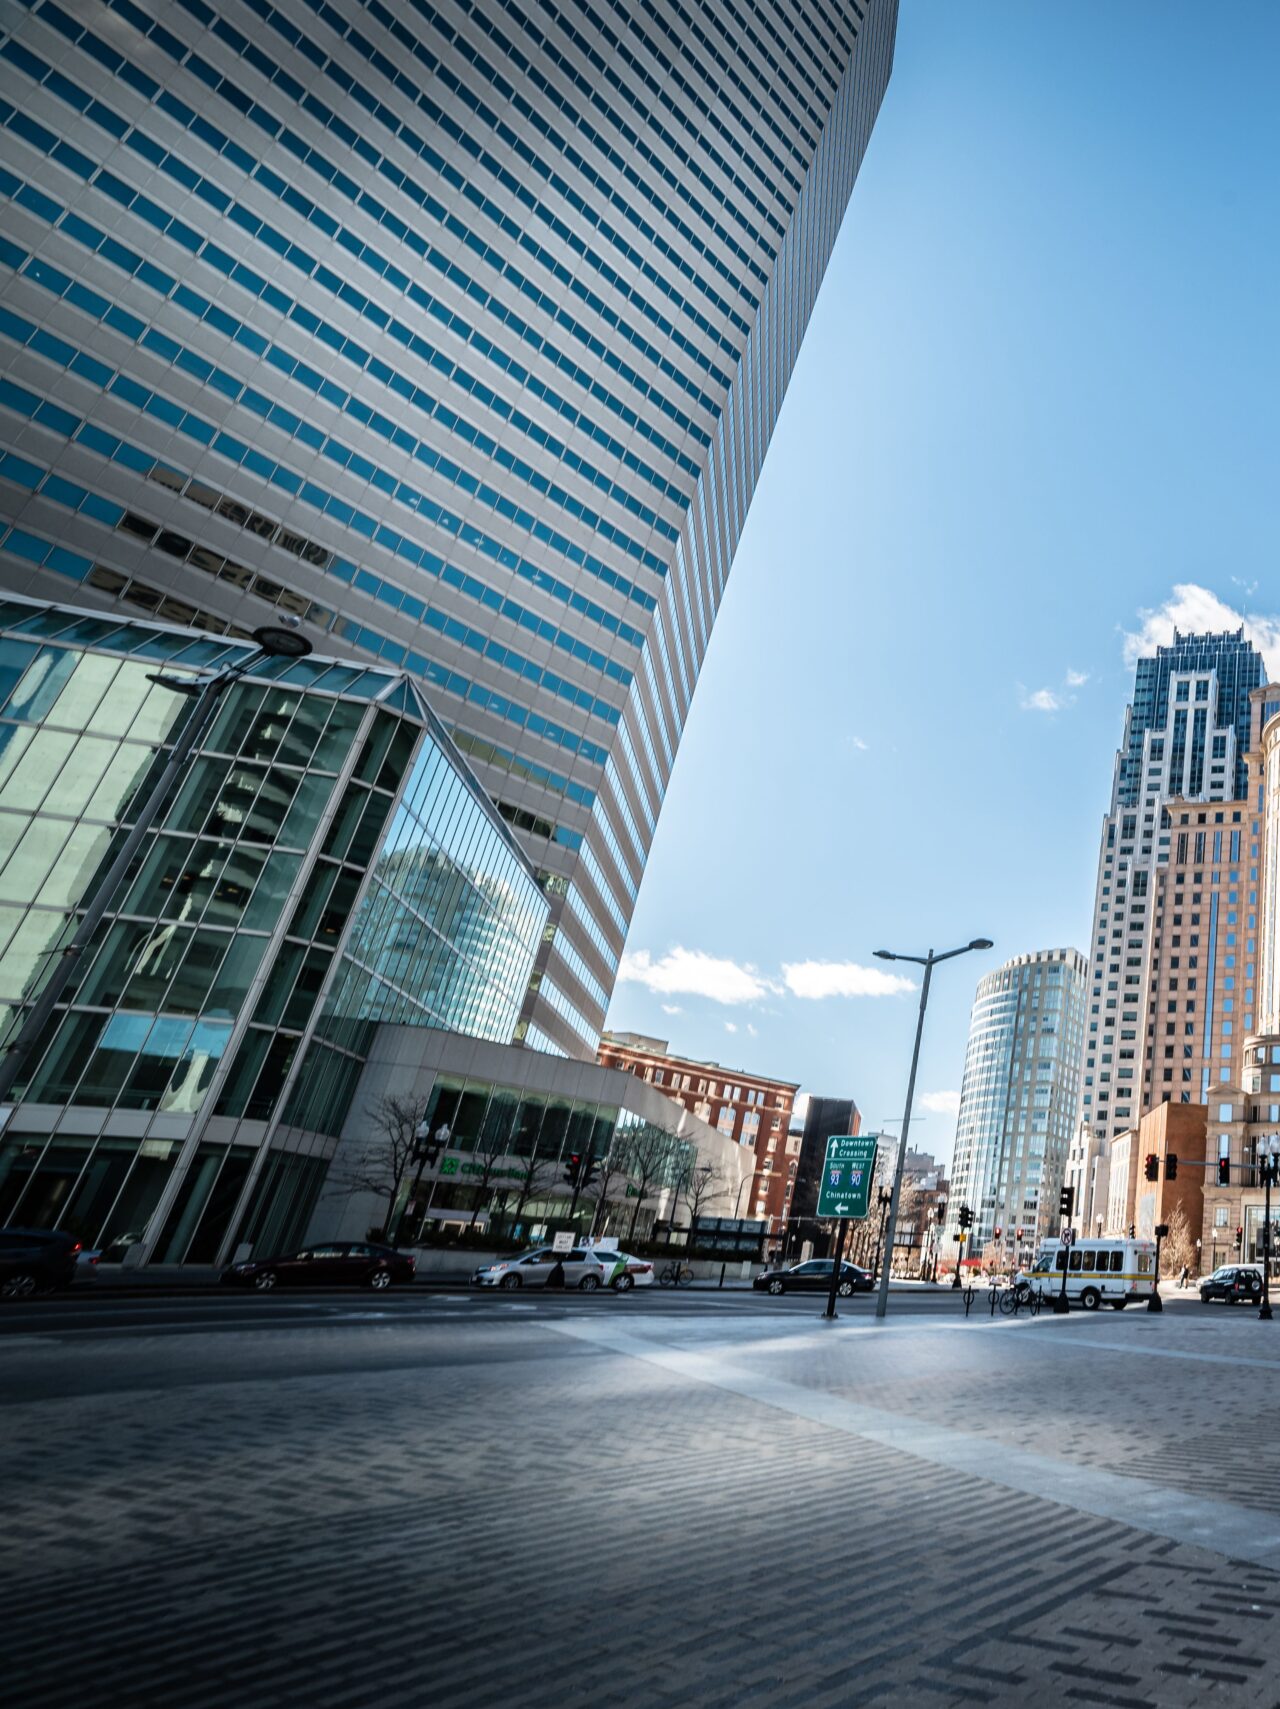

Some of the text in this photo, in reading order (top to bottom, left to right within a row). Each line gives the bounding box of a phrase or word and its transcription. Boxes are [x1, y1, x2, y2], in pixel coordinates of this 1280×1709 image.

[841, 1139, 874, 1147] Downtown
[839, 1149, 868, 1159] Crossing
[830, 1174, 861, 1186] 93 90
[826, 1191, 862, 1200] Chinatown
